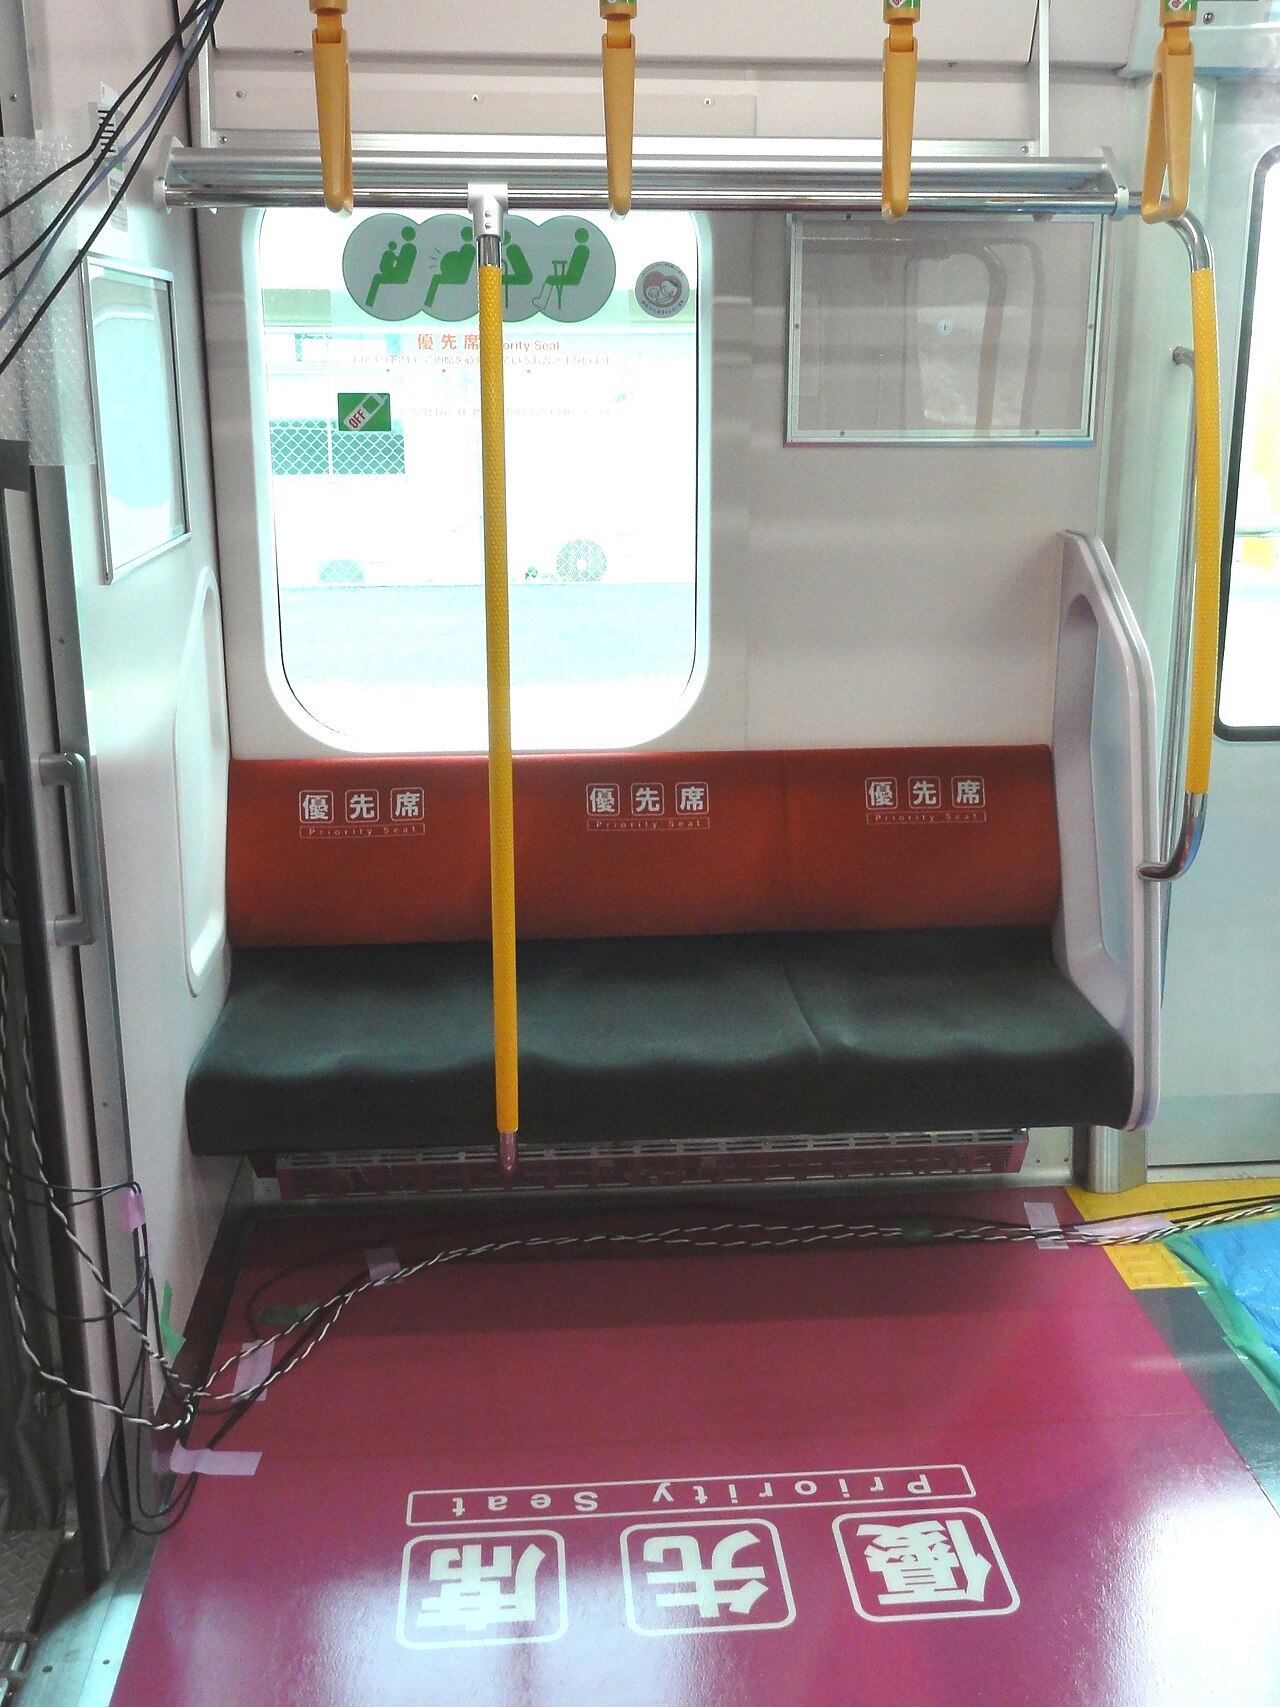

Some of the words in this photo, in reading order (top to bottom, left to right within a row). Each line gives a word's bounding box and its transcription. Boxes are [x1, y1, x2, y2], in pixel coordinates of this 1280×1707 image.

[417, 333, 480, 350] 優先席
[502, 340, 530, 352] ority
[534, 341, 560, 351] Seat
[348, 408, 366, 429] OFF
[589, 786, 705, 813] 優先席
[868, 780, 981, 806] 優先席
[302, 792, 420, 820] 優先席
[596, 820, 657, 829] Priority
[668, 819, 701, 828] Seat
[875, 813, 935, 823] Priority
[945, 813, 978, 821] Seat
[309, 827, 373, 837] Priority
[383, 826, 417, 834] Seat
[652, 1474, 932, 1503] Priority
[452, 1490, 599, 1517] Seat
[416, 1519, 993, 1631] 優先席
